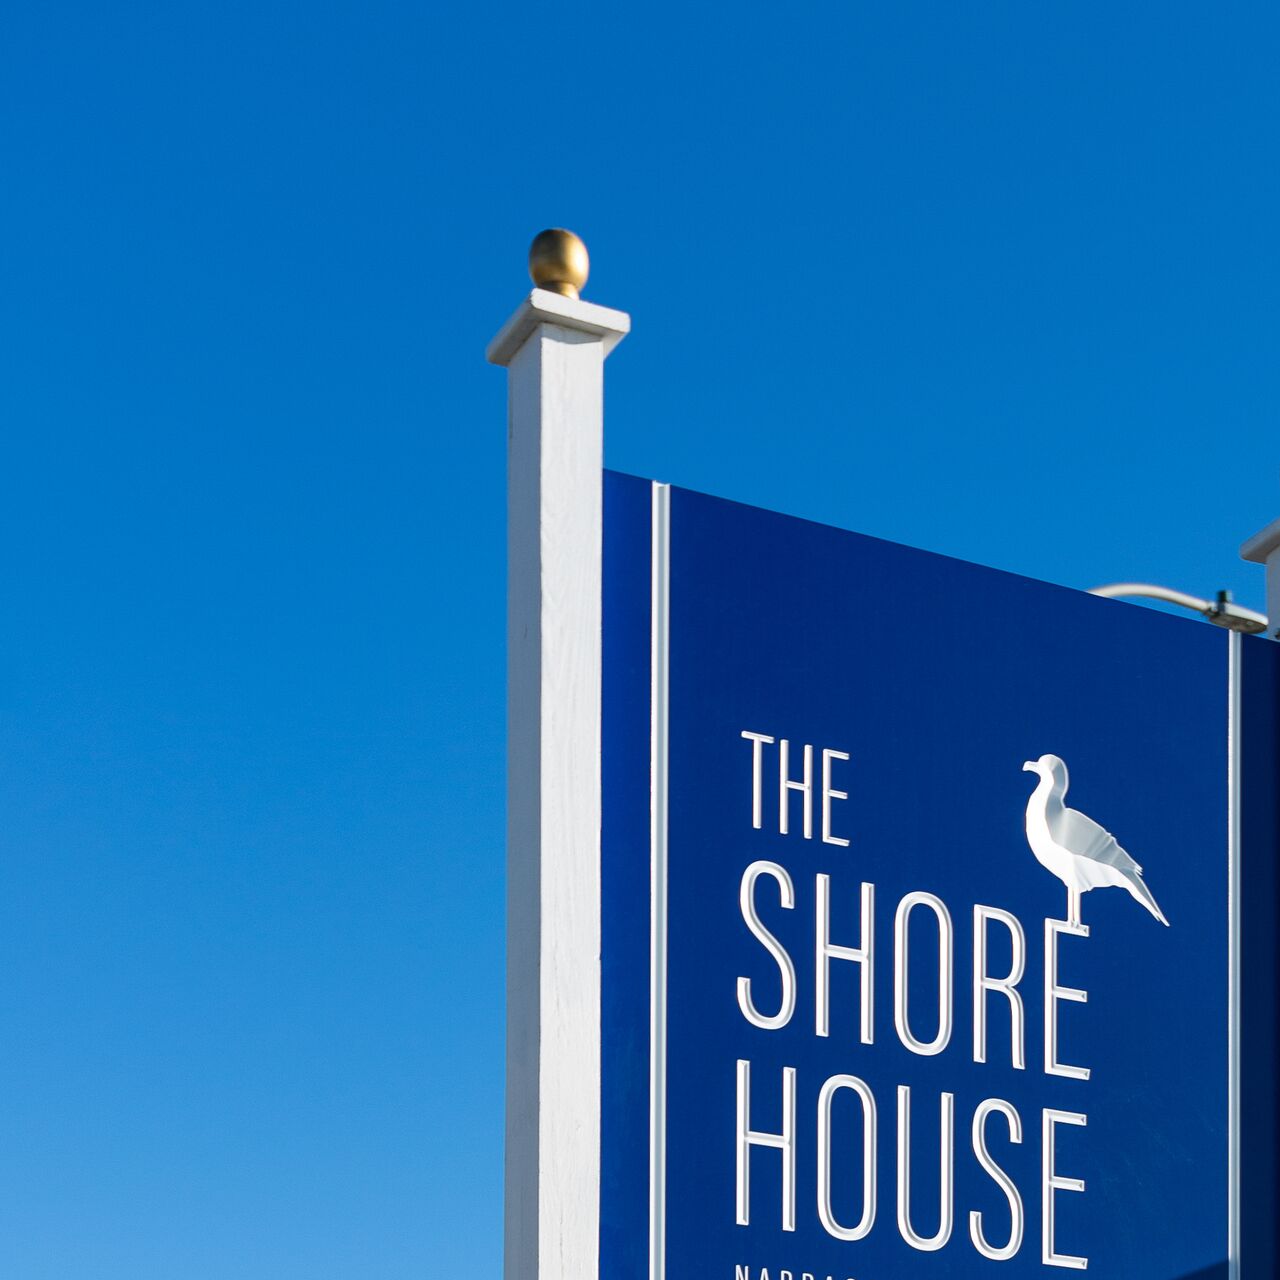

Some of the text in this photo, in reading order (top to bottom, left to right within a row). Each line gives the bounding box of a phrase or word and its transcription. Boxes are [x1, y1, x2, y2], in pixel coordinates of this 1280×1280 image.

[740, 730, 850, 847] THE
[736, 860, 1090, 1081] SHORE
[735, 1059, 1089, 1270] HOUSE
